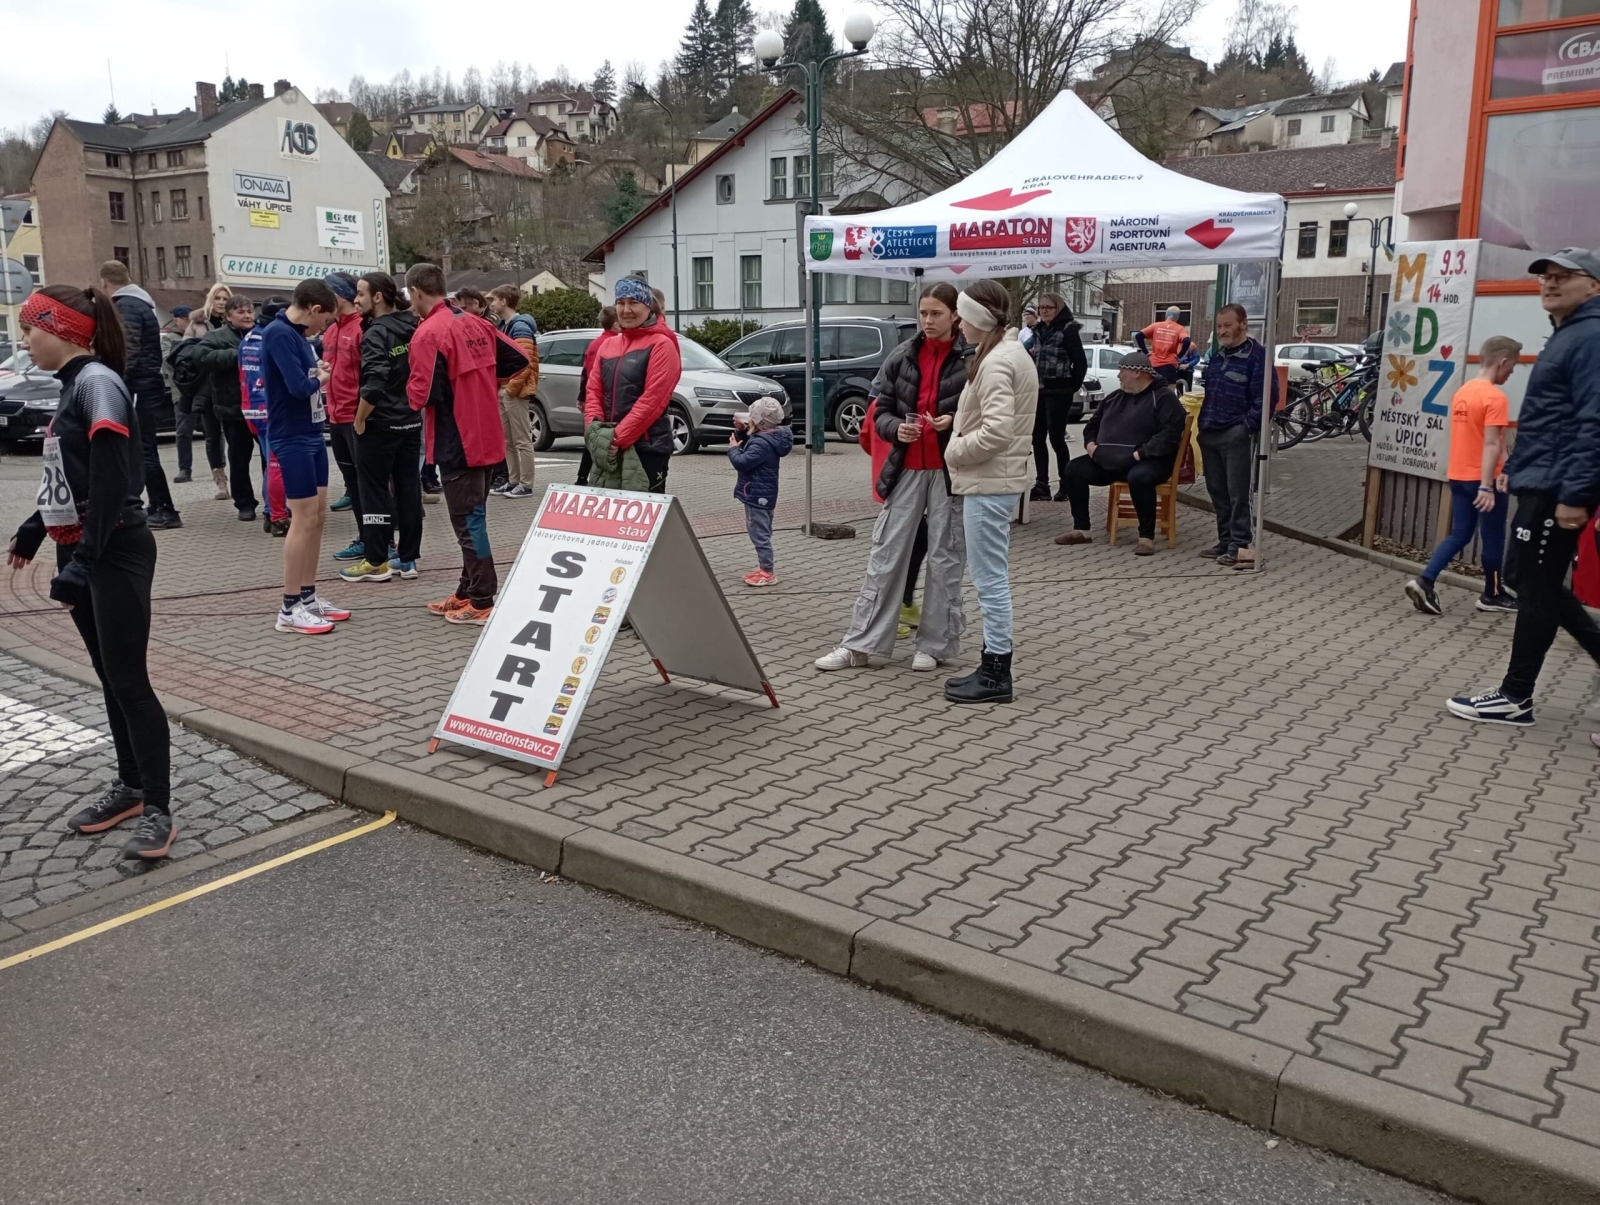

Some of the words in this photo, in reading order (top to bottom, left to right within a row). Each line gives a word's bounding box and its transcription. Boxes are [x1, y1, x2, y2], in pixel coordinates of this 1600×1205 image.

[1546, 67, 1595, 81] PREMIUM
[281, 119, 318, 155] AGB
[235, 173, 286, 195] TONAVA
[1021, 182, 1051, 191] KRAJ
[1023, 174, 1144, 185] KRÁLOVÉHRADECKÝ
[237, 198, 261, 209] VÁHY
[265, 201, 293, 213] ÚPICE
[1110, 215, 1159, 227] NÁRODNÍ
[1218, 209, 1277, 218] KRÁLOVÉHRADECKÝ
[886, 228, 915, 238] ČESKÝ
[950, 217, 1053, 239] MARATON
[1109, 227, 1171, 239] SPORTOVNÍ
[886, 235, 934, 247] ATLETICKÝ
[1022, 236, 1049, 245] stav
[1109, 242, 1167, 251] AGENTURA
[886, 248, 910, 257] SVAZ
[999, 249, 1028, 257] jednota
[227, 260, 278, 275] RYCHLÉ
[1440, 249, 1467, 276] 9.3.
[1427, 284, 1442, 303] 14
[1443, 294, 1460, 304] HOD.
[1380, 408, 1420, 427] MĚSTSKÝ
[1426, 415, 1443, 431] SÁL
[1395, 427, 1428, 448] ÚPICI
[1376, 442, 1393, 451] HUDBA
[1402, 445, 1428, 458] TOMBOLA
[1376, 453, 1397, 464] VSTUPNÉ
[1402, 456, 1438, 471] DOBROVOLNÉ
[544, 491, 663, 525] MARATON
[617, 525, 649, 538] stav
[1516, 526, 1532, 542] 29
[533, 530, 585, 544] tělovýchovná
[586, 539, 619, 549] jednota
[621, 543, 646, 553] Úpice
[488, 550, 587, 722] START
[448, 718, 556, 757] www.maratonstav.cz
